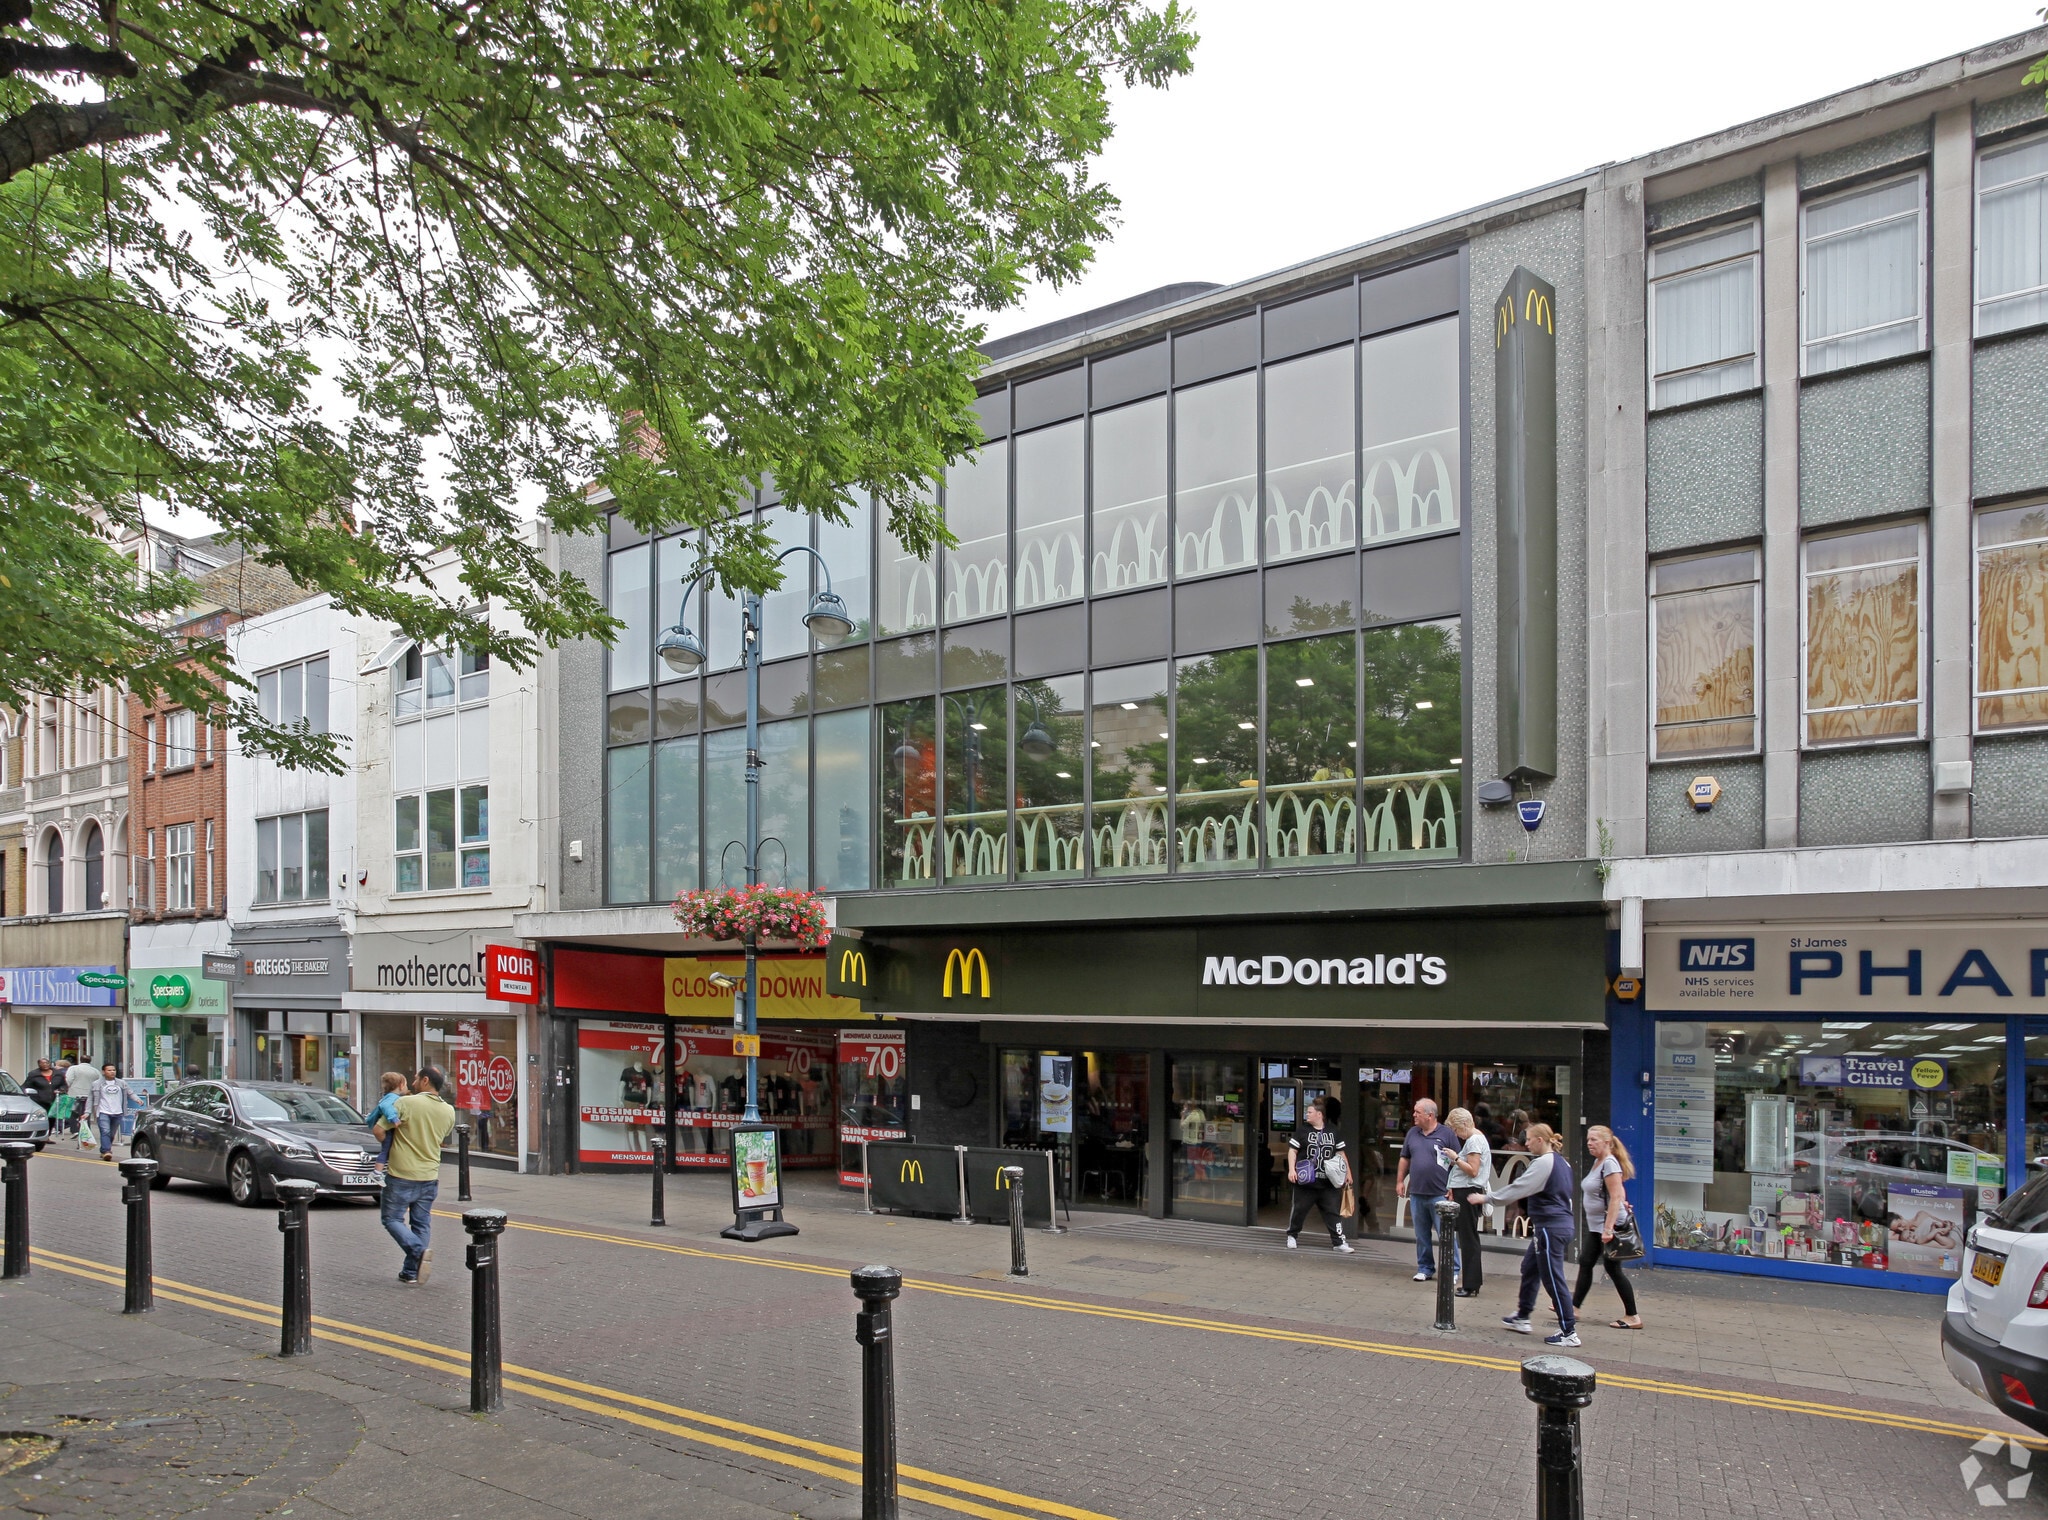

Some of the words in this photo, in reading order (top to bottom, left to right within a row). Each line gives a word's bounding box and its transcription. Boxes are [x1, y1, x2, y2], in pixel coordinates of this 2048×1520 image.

[1695, 785, 1711, 794] ADT
[1790, 938, 1801, 947] St
[1805, 938, 1847, 948] James
[1687, 945, 1747, 966] NHS
[254, 959, 291, 975] GREGGS
[292, 961, 303, 972] THE
[304, 961, 329, 972] BAKERY
[497, 954, 533, 976] NOIR
[1202, 954, 1448, 985] McDonald's
[84, 975, 125, 985] Specsavers
[1685, 977, 1709, 986] NHS
[1713, 977, 1754, 986] services
[14, 970, 92, 1003] WHSmith
[503, 983, 528, 991] MENSWEAR
[760, 977, 822, 998] DOWN
[1620, 982, 1633, 990] ADT
[153, 984, 184, 999] Specsavers
[1679, 988, 1725, 997] available
[1730, 988, 1754, 997] here
[133, 997, 151, 1007] Opticians
[199, 997, 218, 1007] Opticians
[609, 1022, 655, 1031] MENSWEAR
[844, 1032, 872, 1040] MENSWEAR
[153, 1034, 162, 1059] Lenses
[1674, 1055, 1694, 1064] NHS
[1846, 1058, 1904, 1072] Travel
[154, 1060, 163, 1087] Contact
[478, 1076, 487, 1087] off
[1848, 1072, 1903, 1086] Clinic
[582, 1106, 642, 1116] CLOSING
[590, 1114, 634, 1122] DOWN
[346, 1176, 368, 1184] LX63
